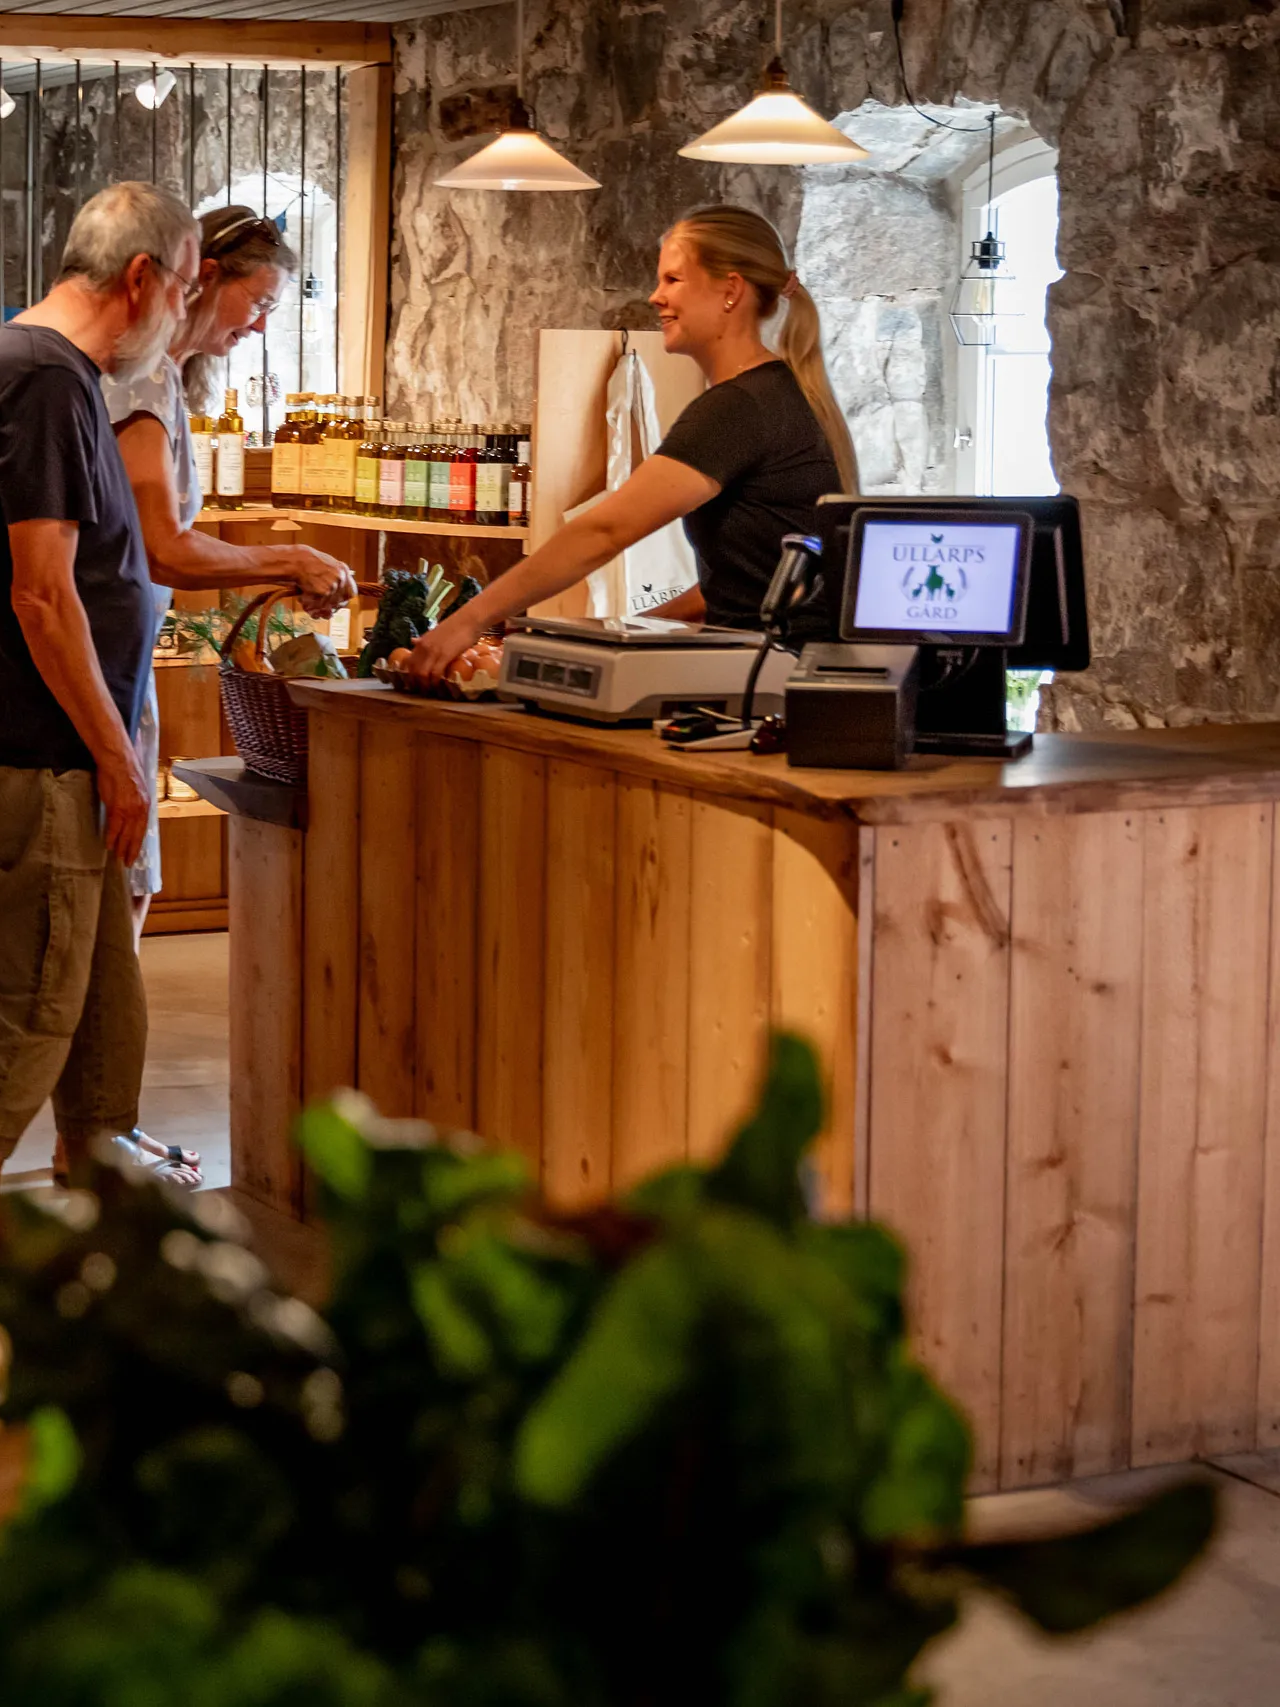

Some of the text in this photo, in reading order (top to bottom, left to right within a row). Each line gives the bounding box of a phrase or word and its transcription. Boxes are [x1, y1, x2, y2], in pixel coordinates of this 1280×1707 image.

[892, 545, 986, 564] ULLARPS
[631, 587, 685, 610] LLARP
[906, 603, 958, 619] GÅRD
